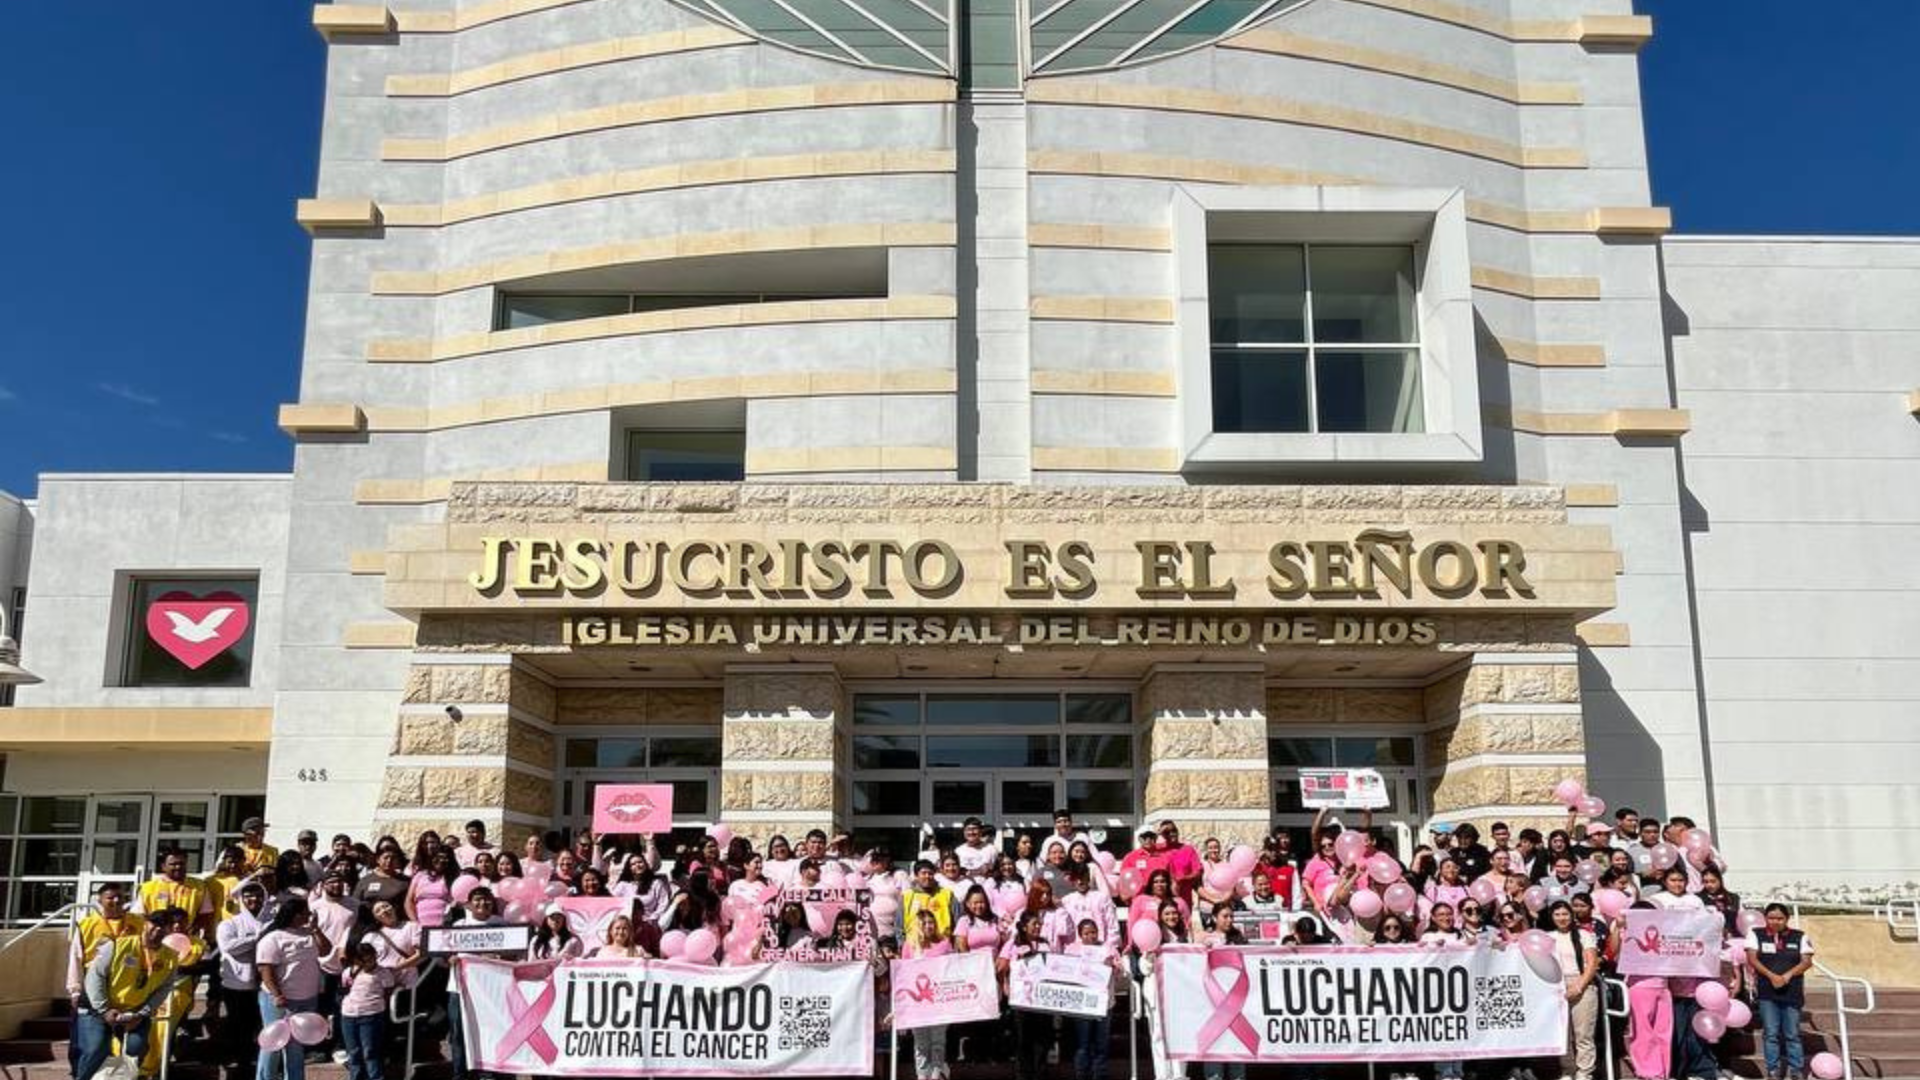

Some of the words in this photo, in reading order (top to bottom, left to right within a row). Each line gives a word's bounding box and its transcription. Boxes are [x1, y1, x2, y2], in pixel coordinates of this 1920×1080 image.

[468, 536, 964, 599] JESUCRISTO
[1003, 540, 1098, 599] ES
[1136, 540, 1236, 599] EL
[1266, 529, 1536, 599] SEÑOR
[562, 615, 738, 645] IGLESIA
[753, 615, 1003, 645] UNIVERSAL
[1019, 615, 1099, 645] DEL
[1118, 615, 1250, 645] REINO
[1262, 615, 1318, 645] DE
[1333, 615, 1437, 645] DIOS
[761, 948, 813, 961] GREATER
[563, 980, 772, 1031] LUCHANDO
[1259, 965, 1469, 1016] LUCHANDO
[1267, 1018, 1350, 1044] CONTRA
[1359, 1018, 1382, 1043] EL
[1389, 1016, 1469, 1042] CANCER
[565, 1031, 643, 1057] CONTRA
[652, 1031, 676, 1058] EL
[683, 1032, 768, 1060] CANCER
